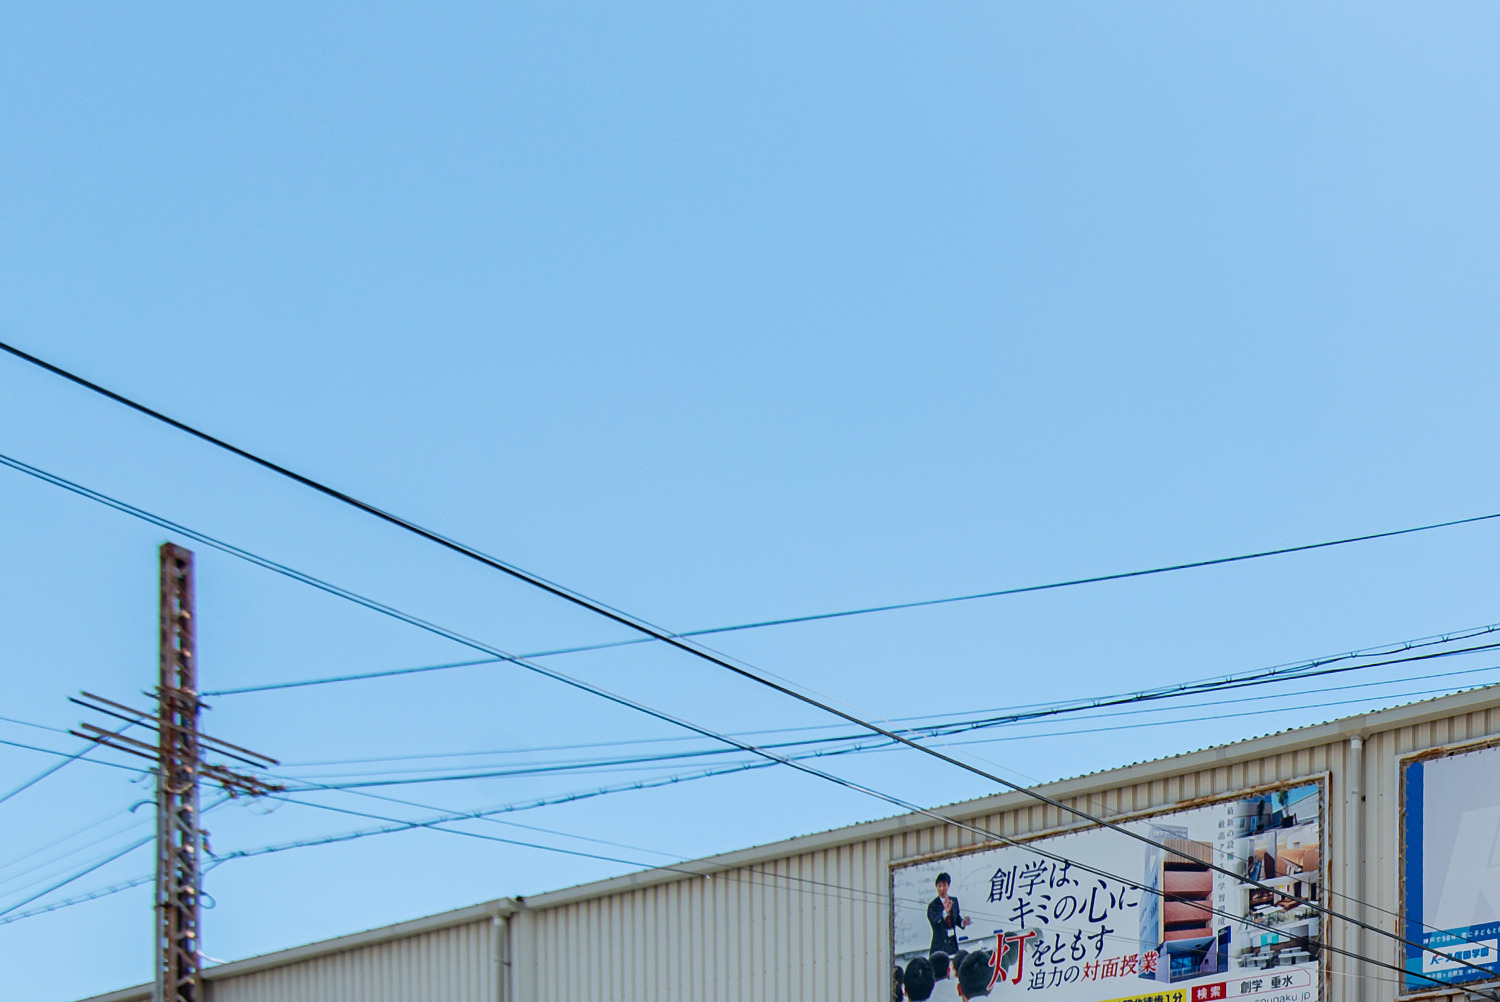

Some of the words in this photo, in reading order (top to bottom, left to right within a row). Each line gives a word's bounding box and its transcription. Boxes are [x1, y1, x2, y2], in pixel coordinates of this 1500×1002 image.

[986, 859, 1080, 903] 創学は、
[1009, 879, 1139, 930] キミの心に
[1027, 950, 1159, 991] 迫力の対面授業
[1197, 985, 1222, 999] 検索
